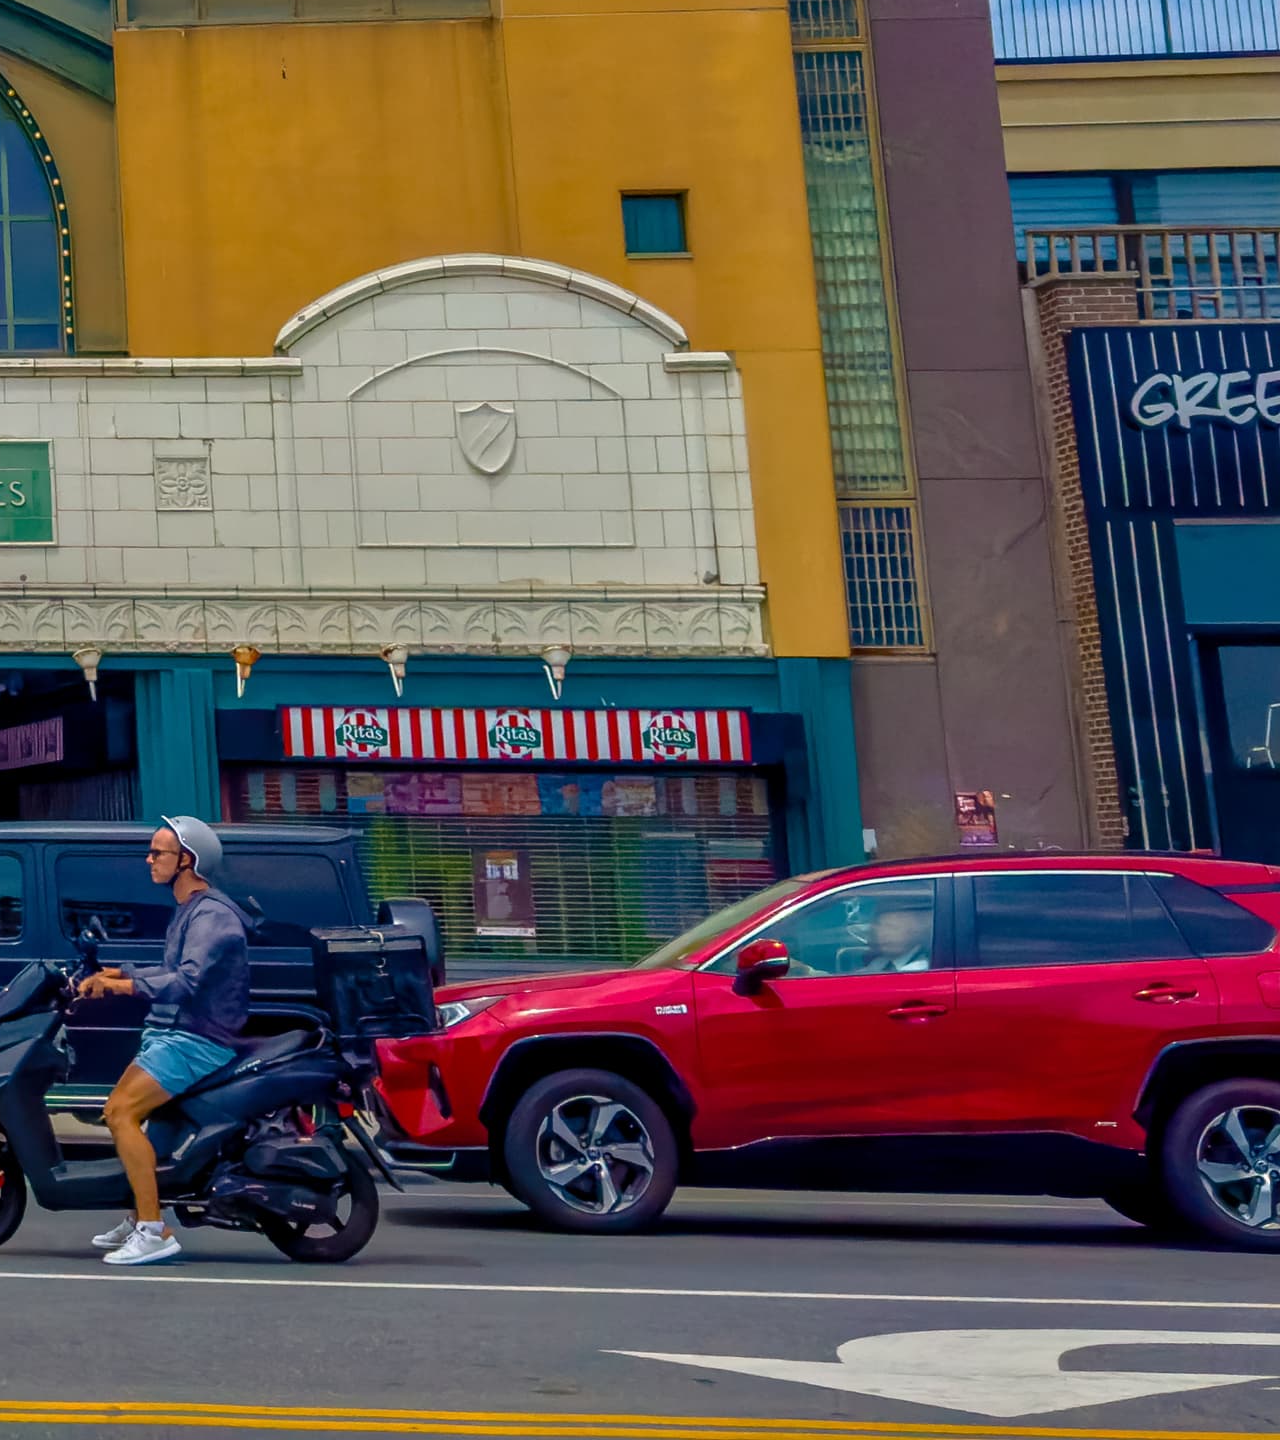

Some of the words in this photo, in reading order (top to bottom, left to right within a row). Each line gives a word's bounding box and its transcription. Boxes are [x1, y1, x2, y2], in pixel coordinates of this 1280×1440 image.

[343, 723, 383, 742] Rita's
[495, 725, 536, 743] Rita's
[649, 726, 691, 744] Rita's
